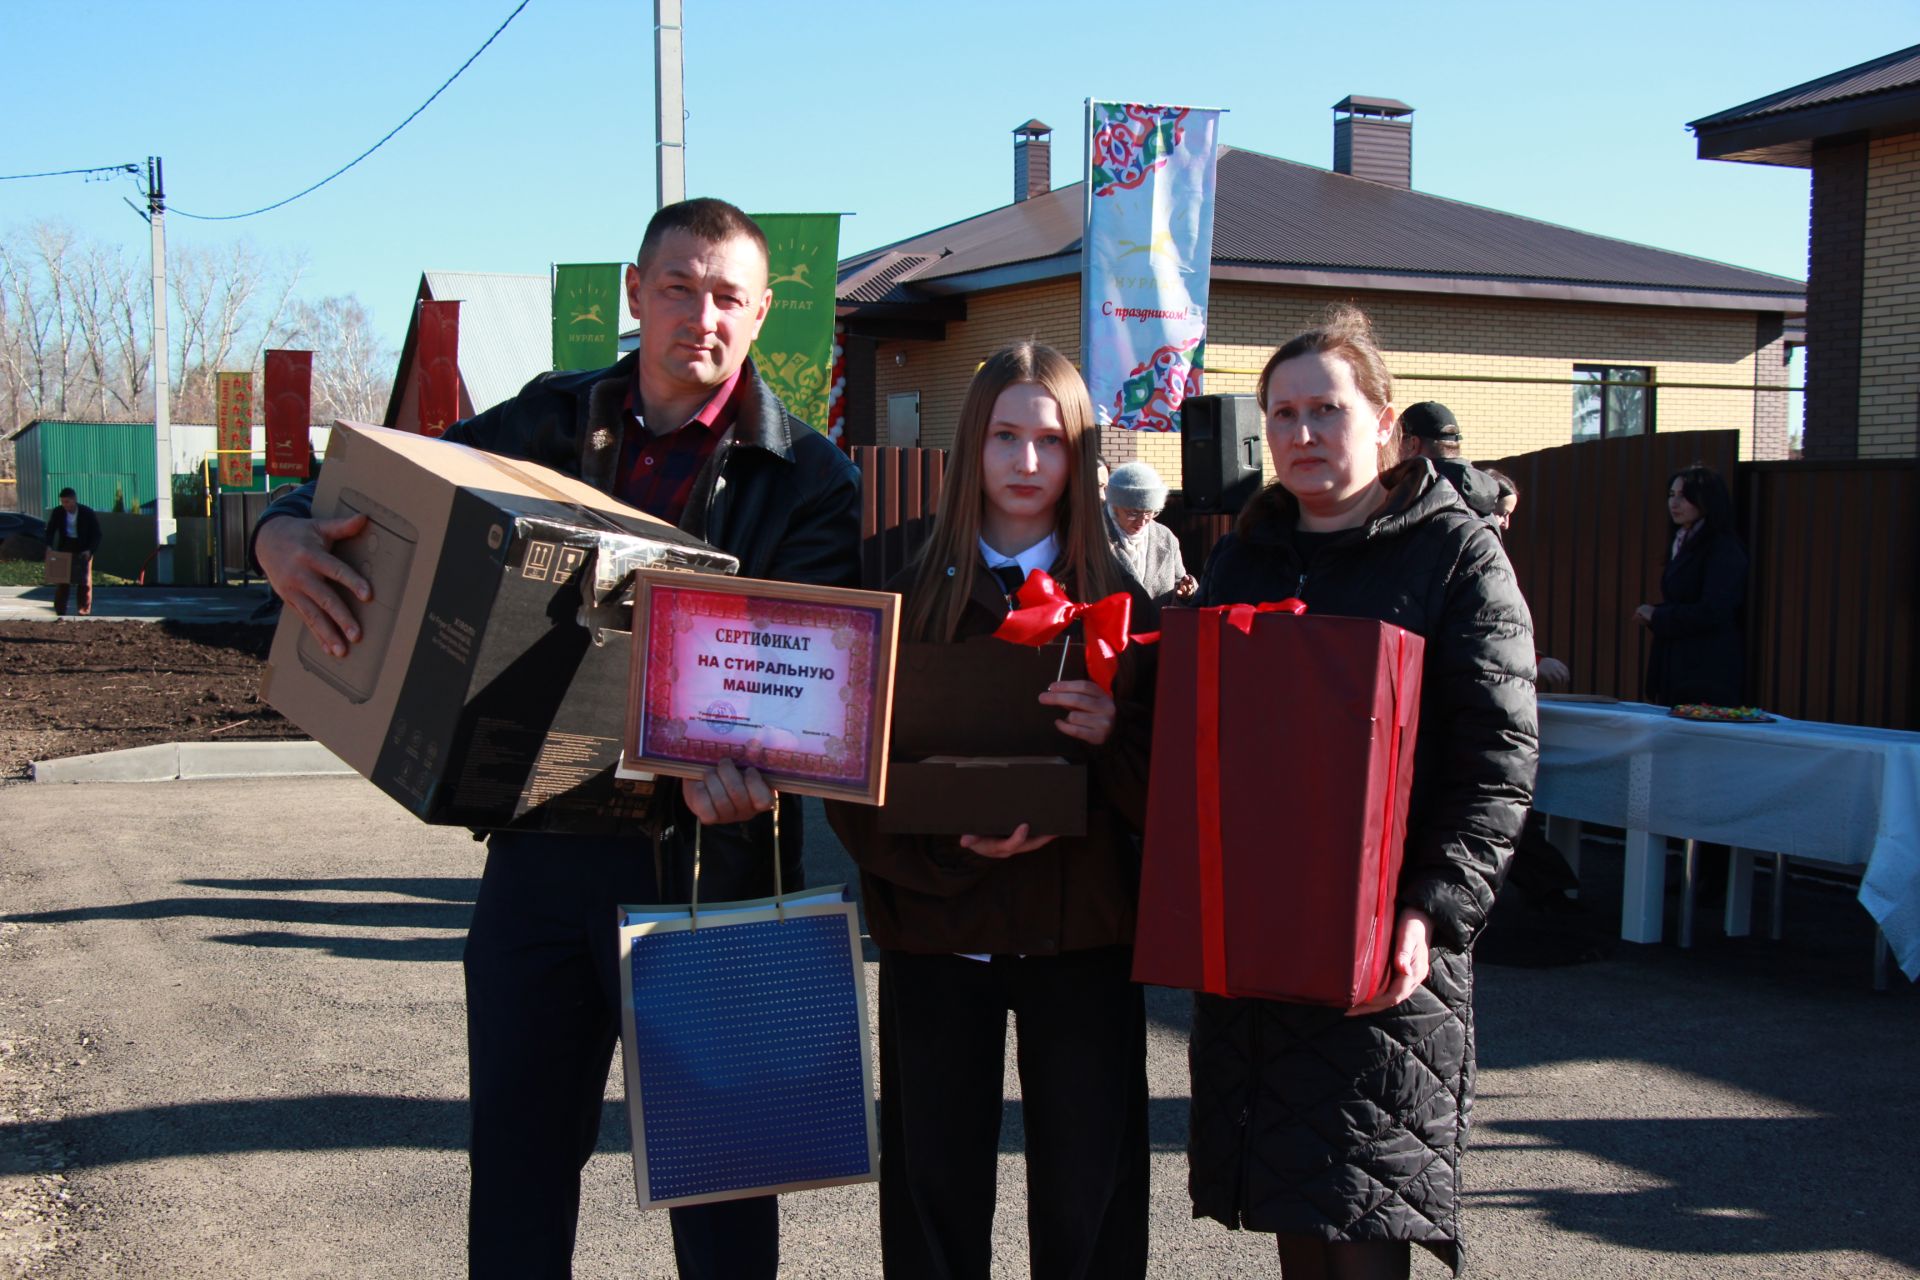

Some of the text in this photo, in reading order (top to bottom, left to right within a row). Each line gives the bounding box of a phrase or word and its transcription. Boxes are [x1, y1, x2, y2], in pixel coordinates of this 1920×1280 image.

[769, 299, 813, 311] УРЛАТ
[1102, 301, 1188, 322] С праздником!
[715, 628, 811, 651] СЕРТИФИКАТ
[698, 654, 835, 681] НА СТИРАЛЬНУЮ
[723, 678, 803, 698] МАШИНКУ
